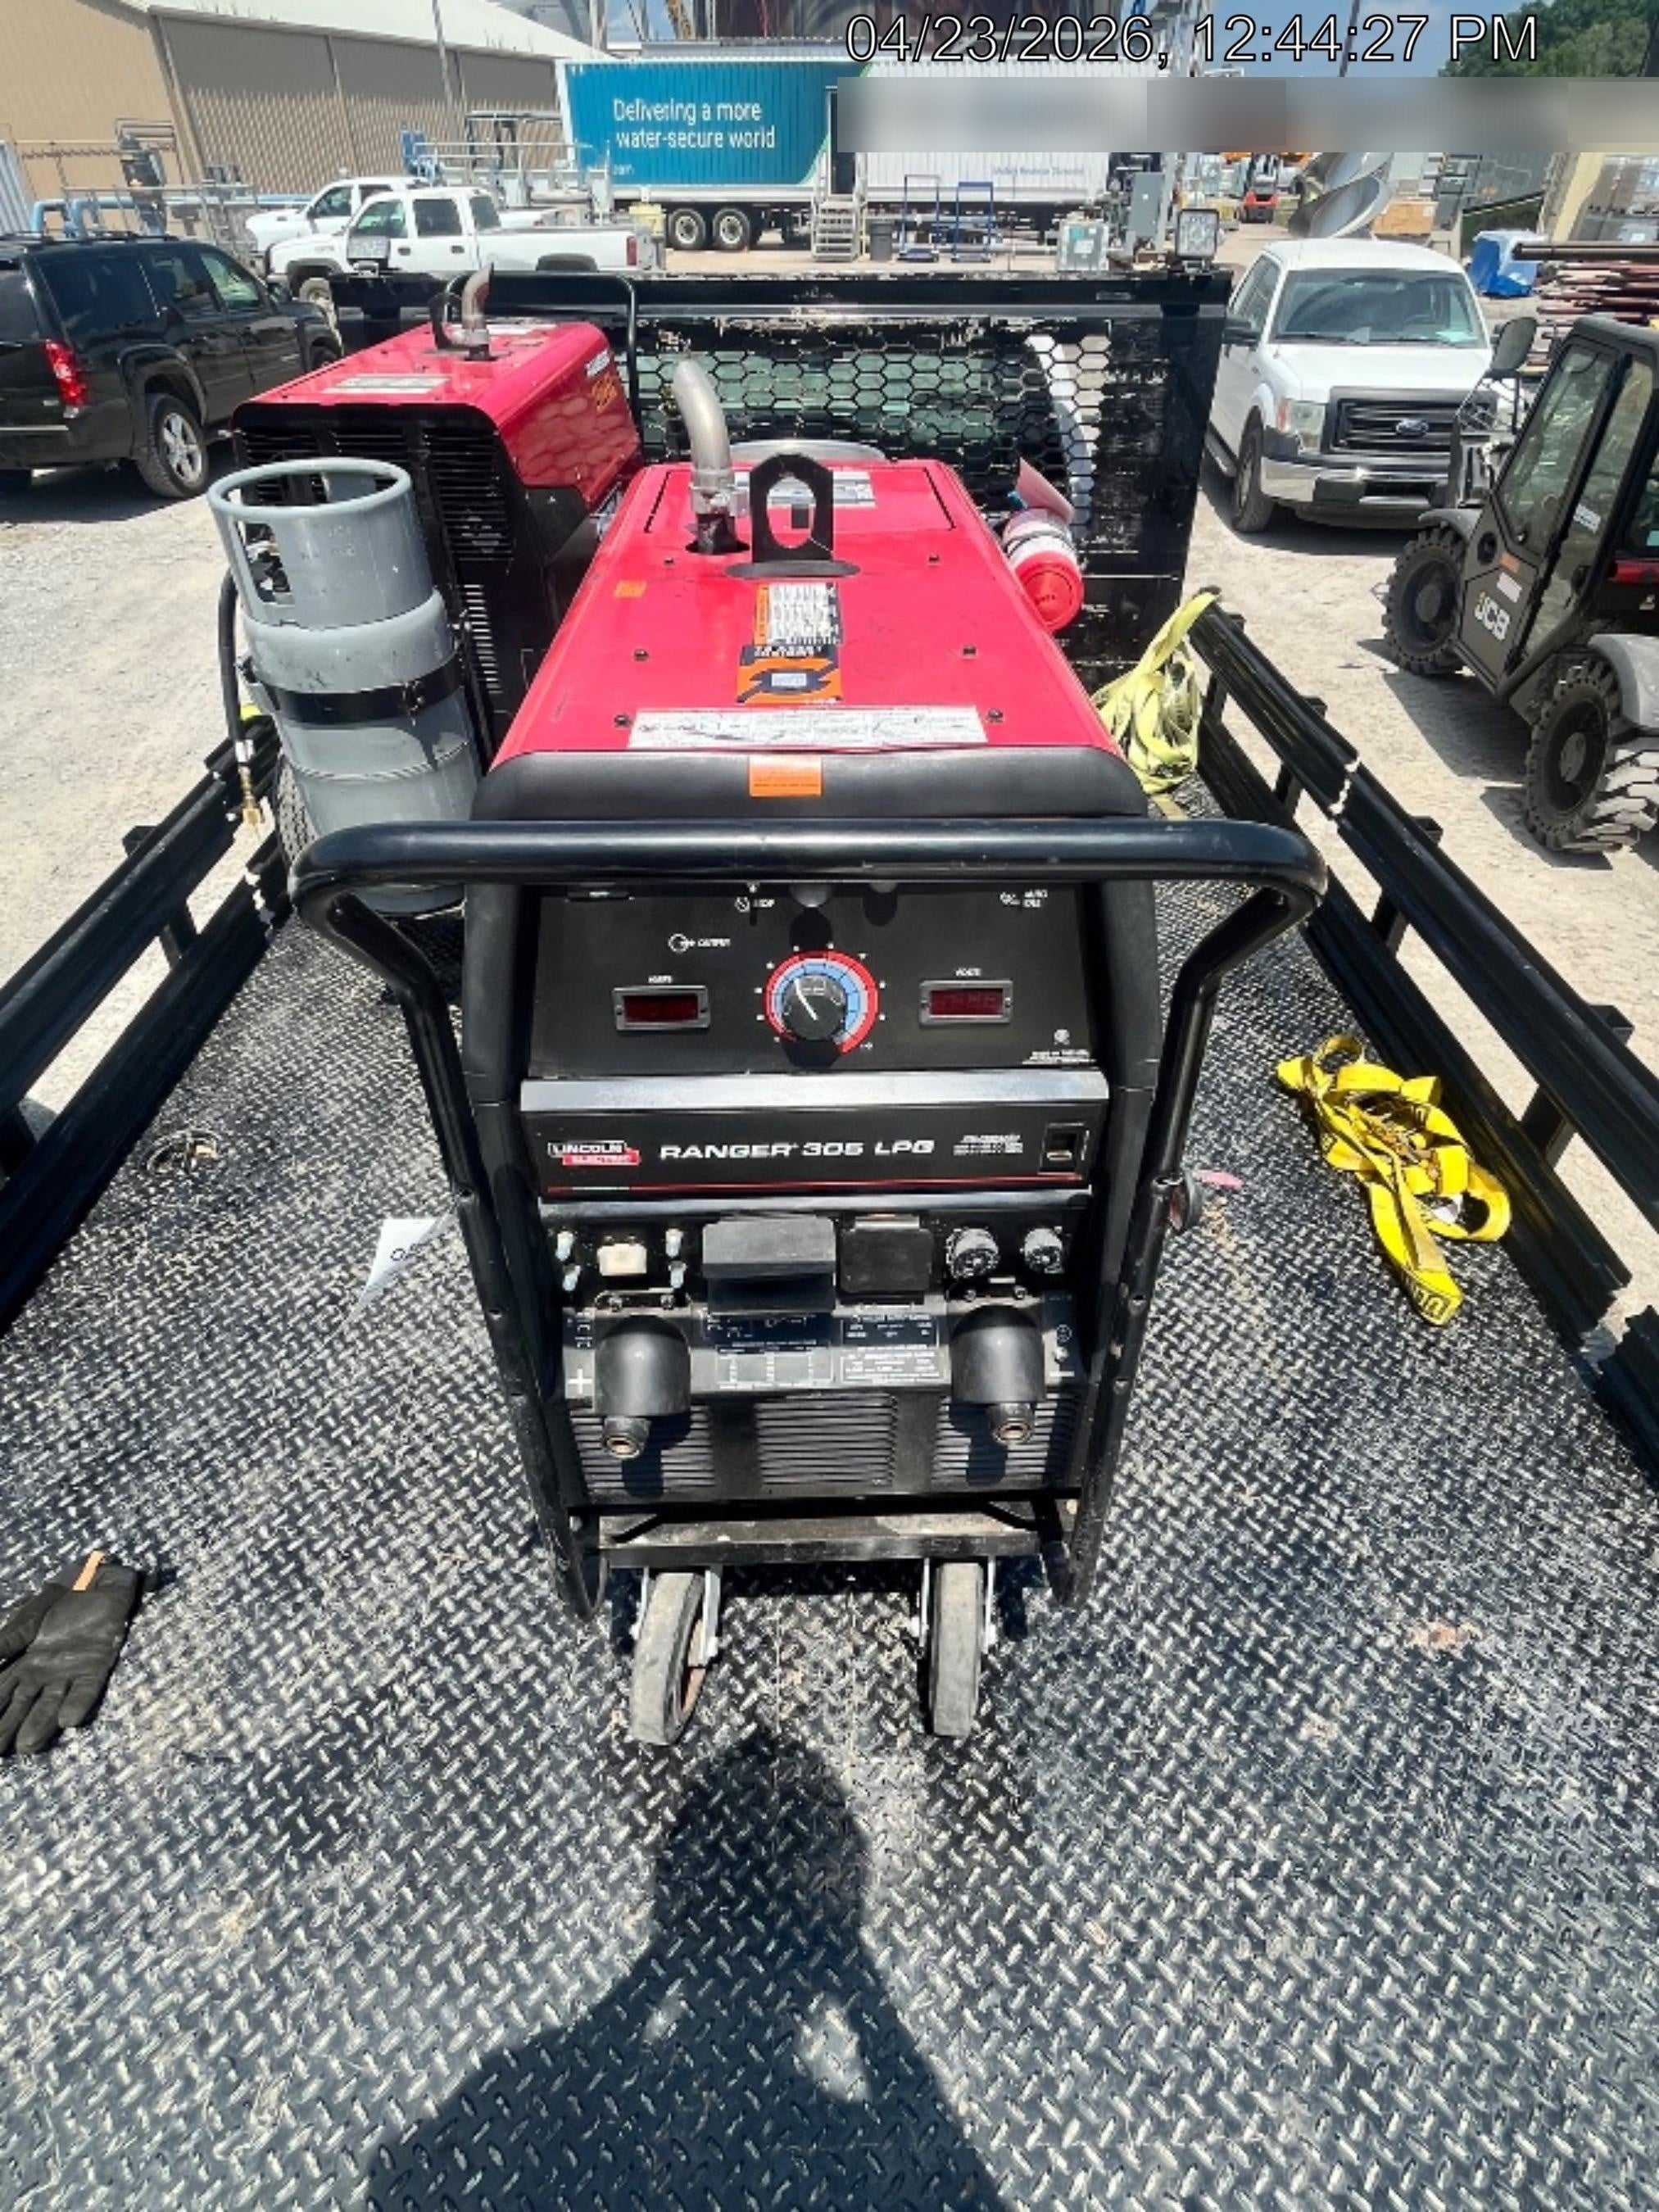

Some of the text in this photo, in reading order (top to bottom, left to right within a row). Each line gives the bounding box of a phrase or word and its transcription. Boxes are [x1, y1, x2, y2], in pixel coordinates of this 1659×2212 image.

[614, 97, 762, 126] Delivering a more
[616, 125, 776, 148] water-secure world
[1475, 593, 1511, 641] JCB
[552, 1143, 623, 1154] LINCOLN
[802, 1141, 864, 1156] 305
[874, 1140, 935, 1156] LPG
